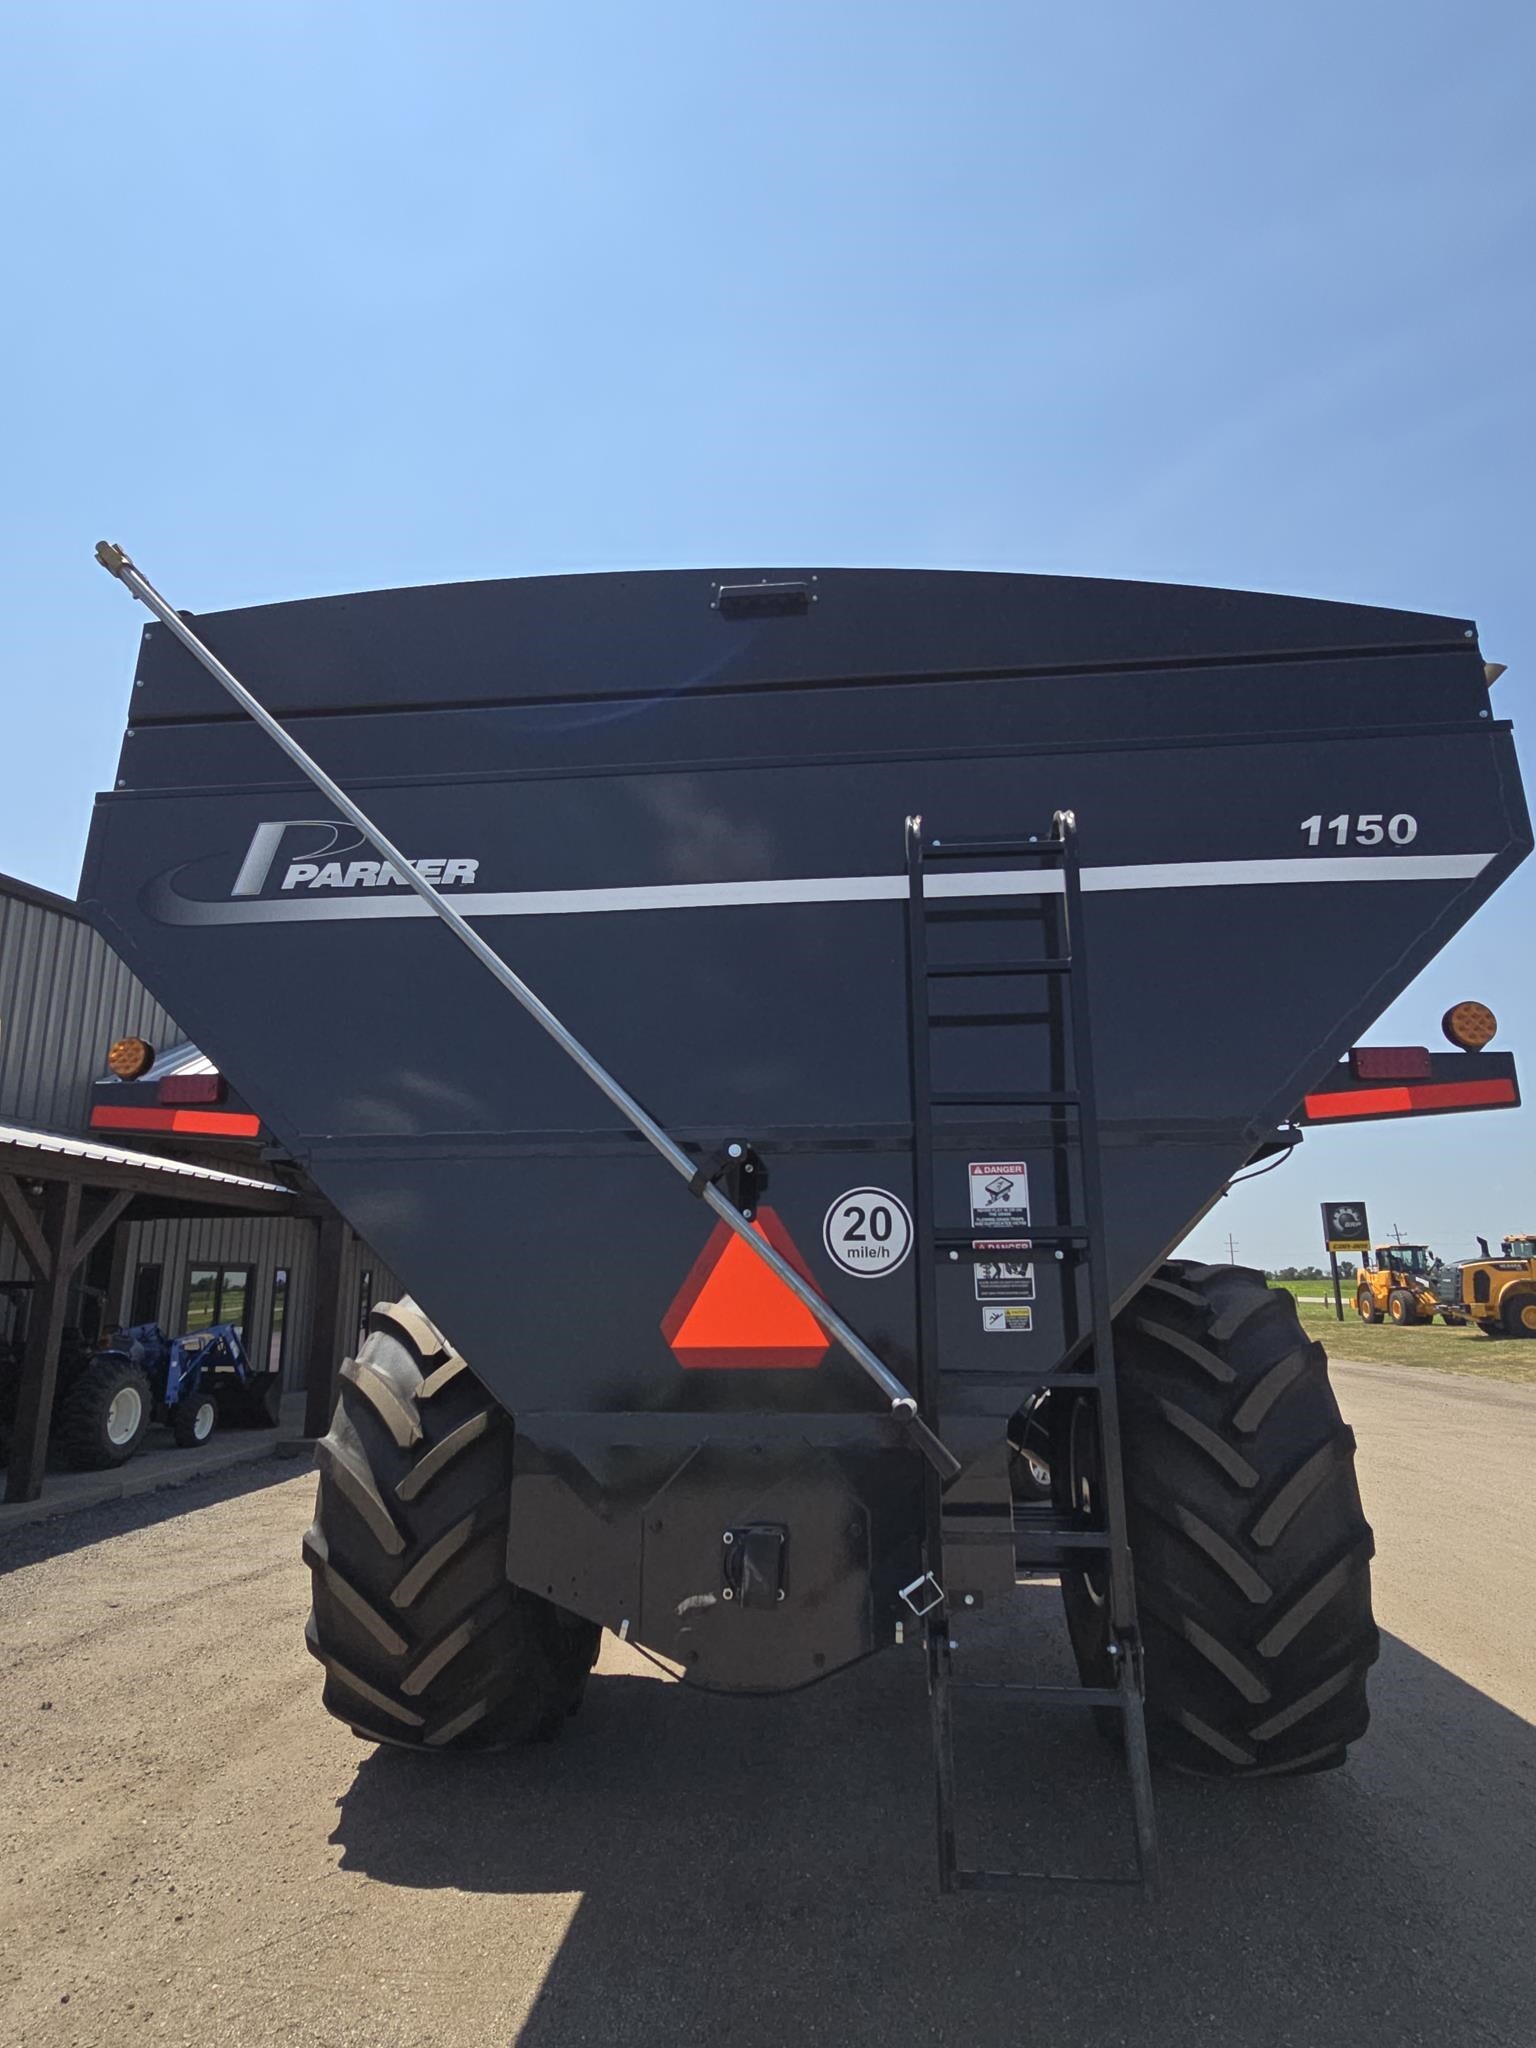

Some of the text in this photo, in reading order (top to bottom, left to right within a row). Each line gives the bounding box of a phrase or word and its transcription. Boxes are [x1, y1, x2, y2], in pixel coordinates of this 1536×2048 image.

[1300, 813, 1418, 846] 1150
[280, 858, 480, 890] PARKER
[984, 1165, 1023, 1174] DANGER
[842, 1205, 893, 1242] 20
[847, 1246, 890, 1259] mile/h
